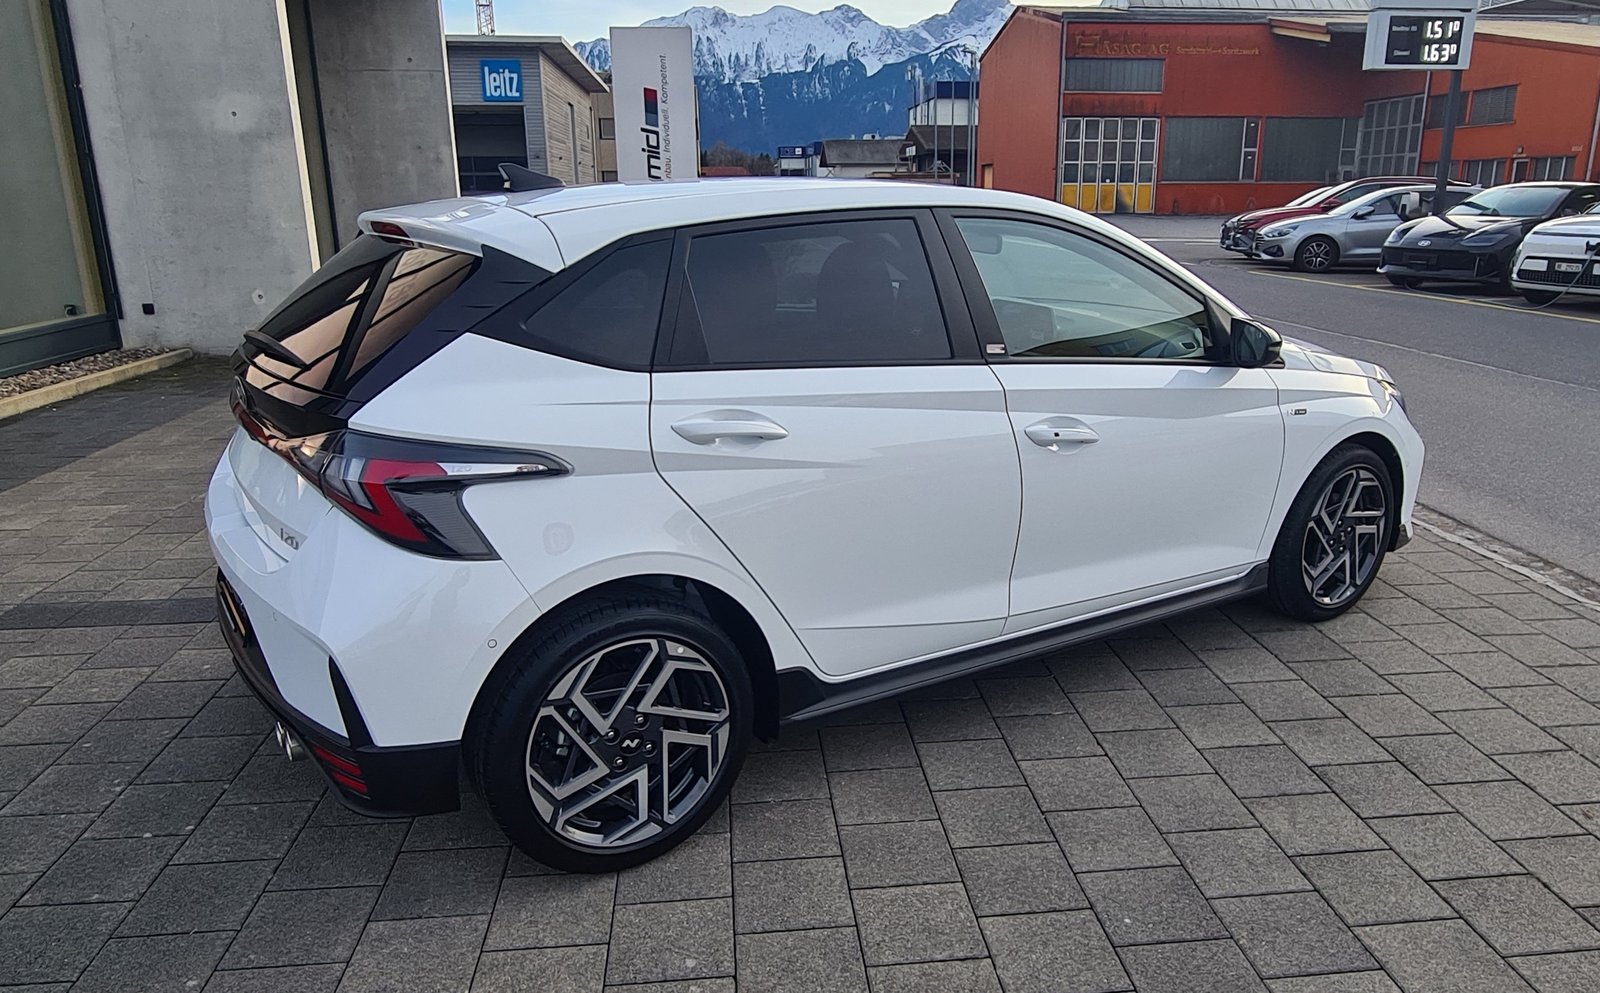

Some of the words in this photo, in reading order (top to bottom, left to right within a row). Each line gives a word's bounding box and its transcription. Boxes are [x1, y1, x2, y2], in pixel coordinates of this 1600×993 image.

[484, 66, 520, 97] leitz
[659, 53, 670, 105] Kompetent.
[640, 127, 664, 182] mid
